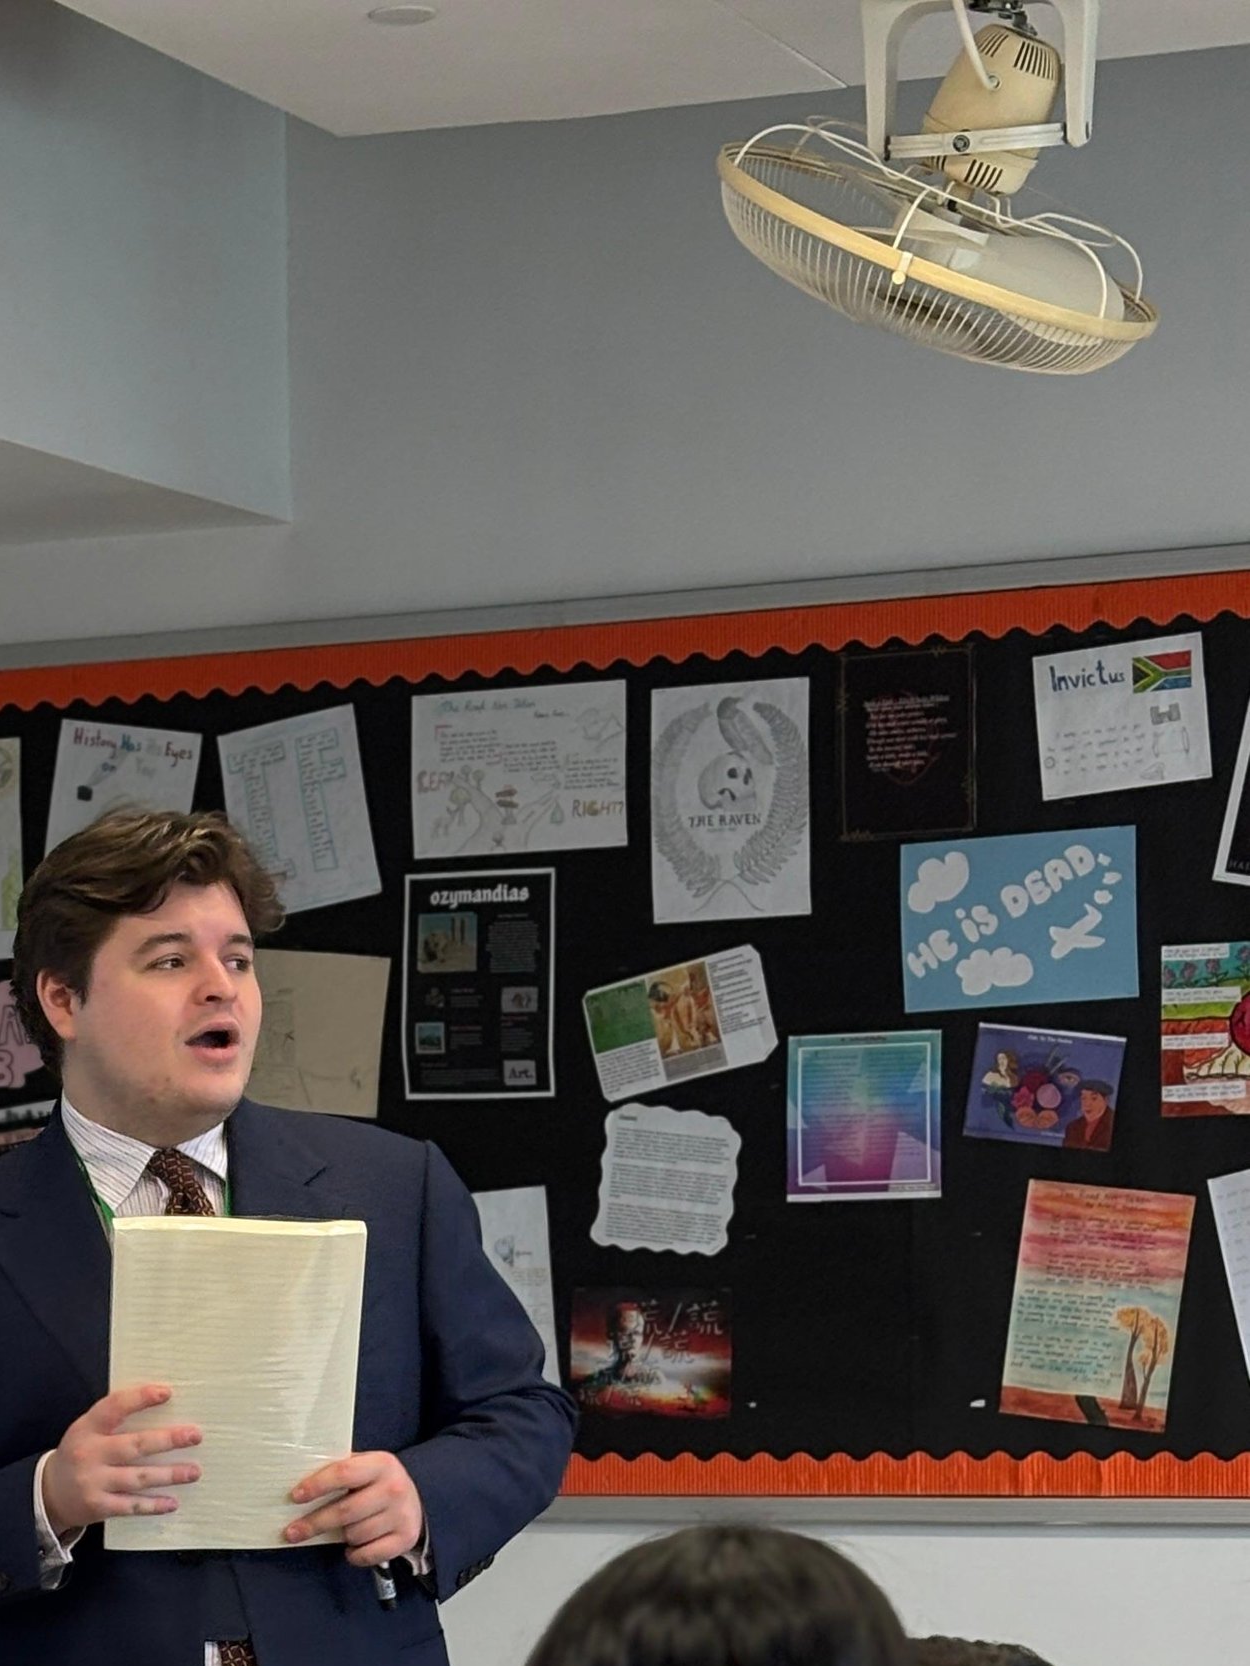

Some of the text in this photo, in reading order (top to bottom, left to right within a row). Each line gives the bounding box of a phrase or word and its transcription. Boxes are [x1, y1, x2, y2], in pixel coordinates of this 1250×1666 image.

[1049, 660, 1125, 692] Invictus
[73, 727, 117, 759] History
[165, 740, 193, 768] Eyes
[688, 812, 761, 828] THE RAVEN
[430, 884, 530, 909] ozymandias
[907, 929, 959, 978] HE
